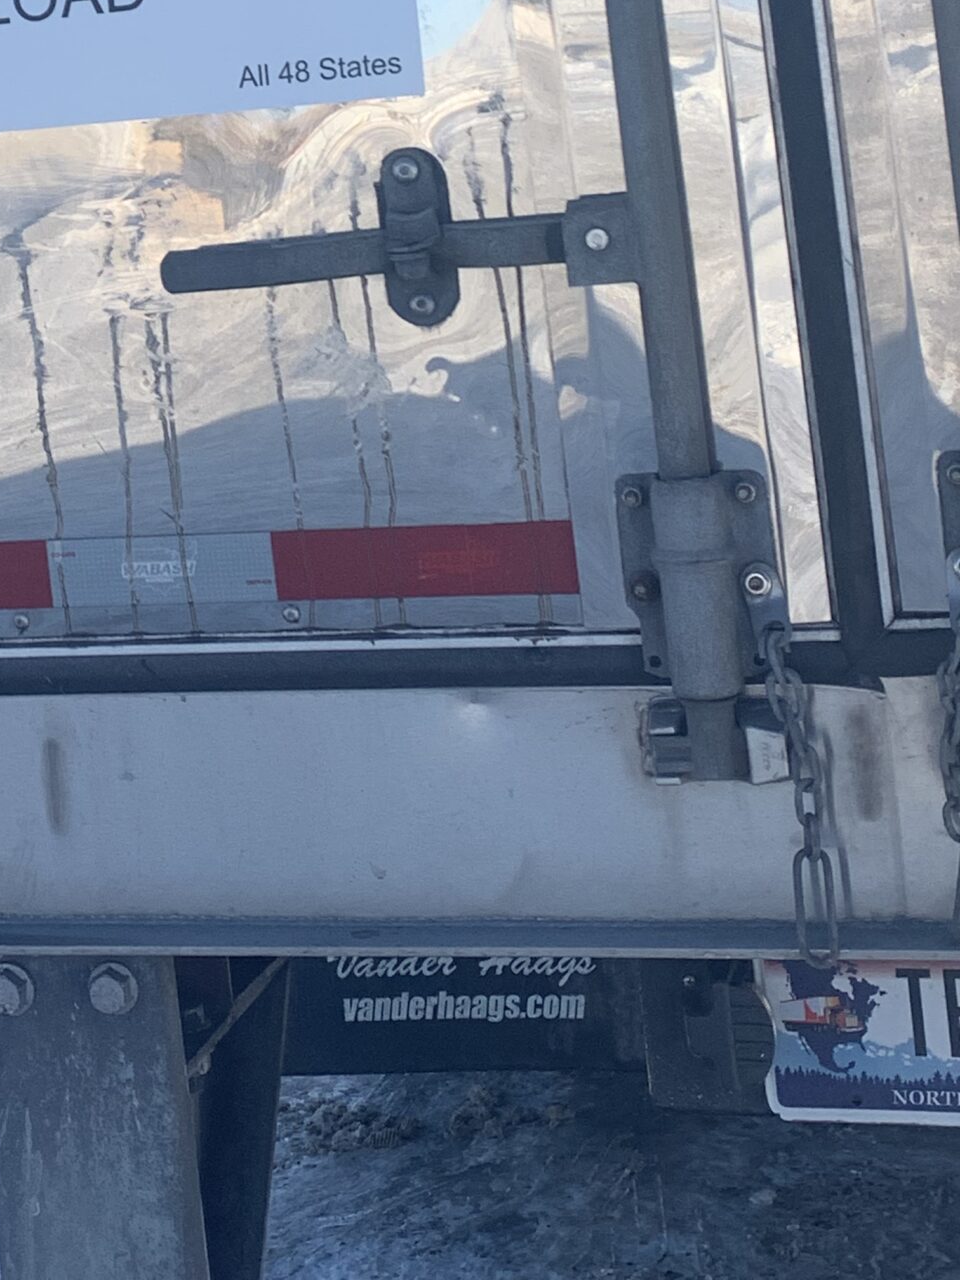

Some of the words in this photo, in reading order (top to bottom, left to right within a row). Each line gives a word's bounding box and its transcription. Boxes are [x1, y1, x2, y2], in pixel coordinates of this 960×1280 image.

[239, 63, 270, 88] All
[278, 60, 310, 84] 48
[319, 55, 402, 80] States
[343, 991, 585, 1022] vanderhaags.com
